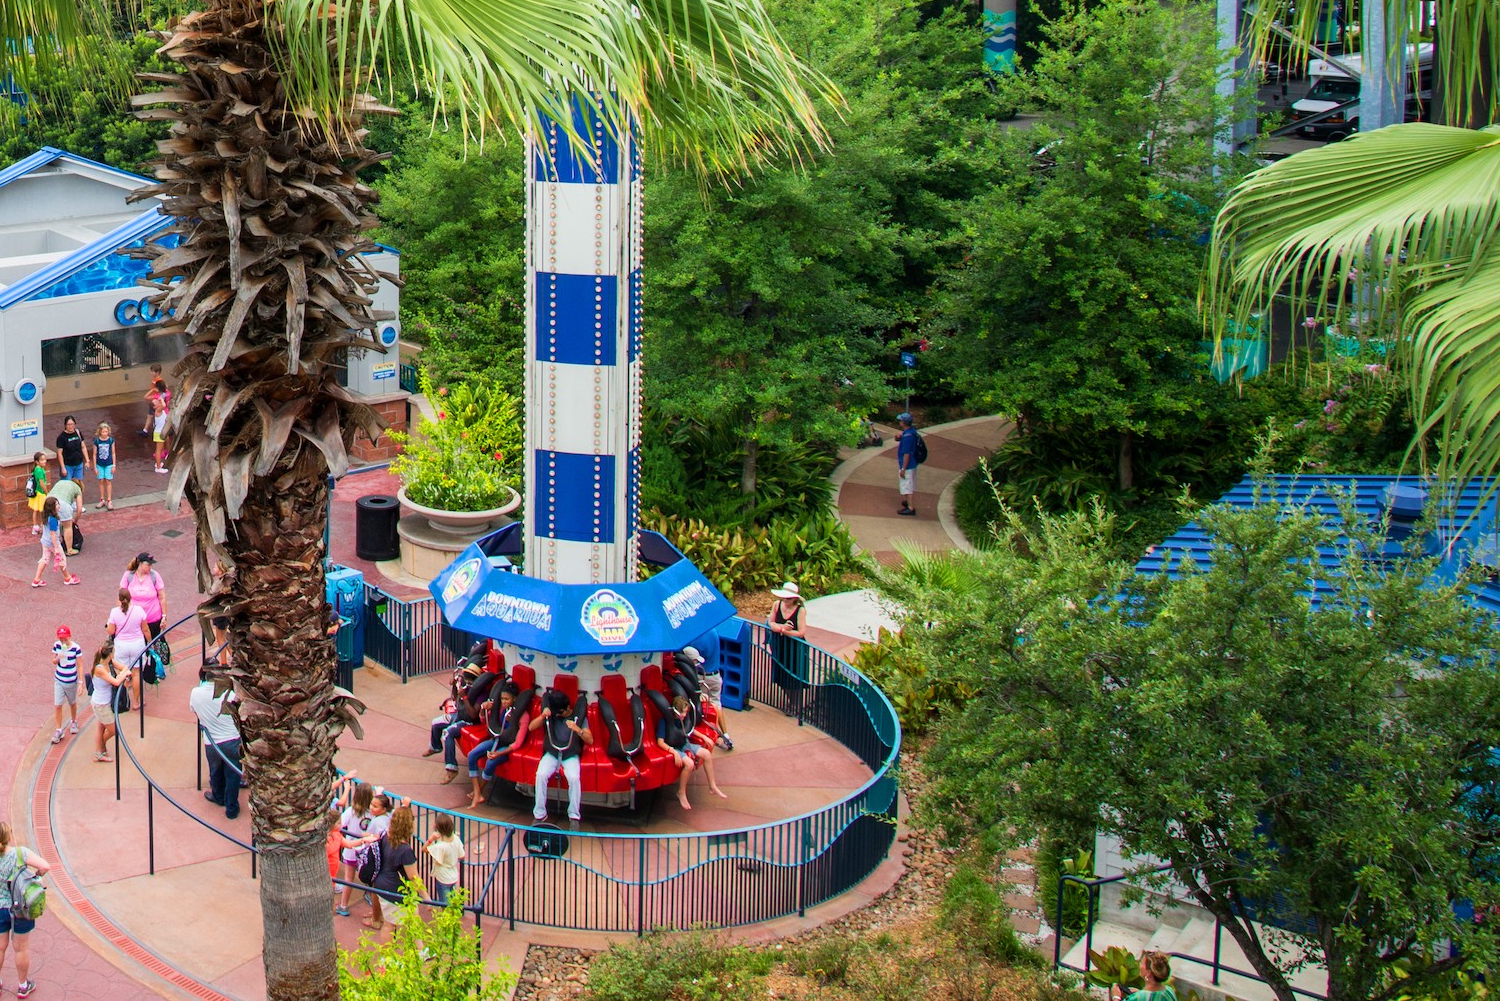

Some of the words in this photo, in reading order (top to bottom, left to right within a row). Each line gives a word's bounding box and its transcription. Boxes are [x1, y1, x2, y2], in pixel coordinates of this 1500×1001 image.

[13, 420, 36, 429] CAUTION
[487, 591, 551, 614] DOWNTOWN
[662, 579, 703, 611] DOWNTOWN
[471, 593, 552, 631] AQUARIUM
[662, 586, 717, 629] AQUARIUM
[590, 614, 633, 628] Lighthouse
[841, 665, 857, 679] EXIT
